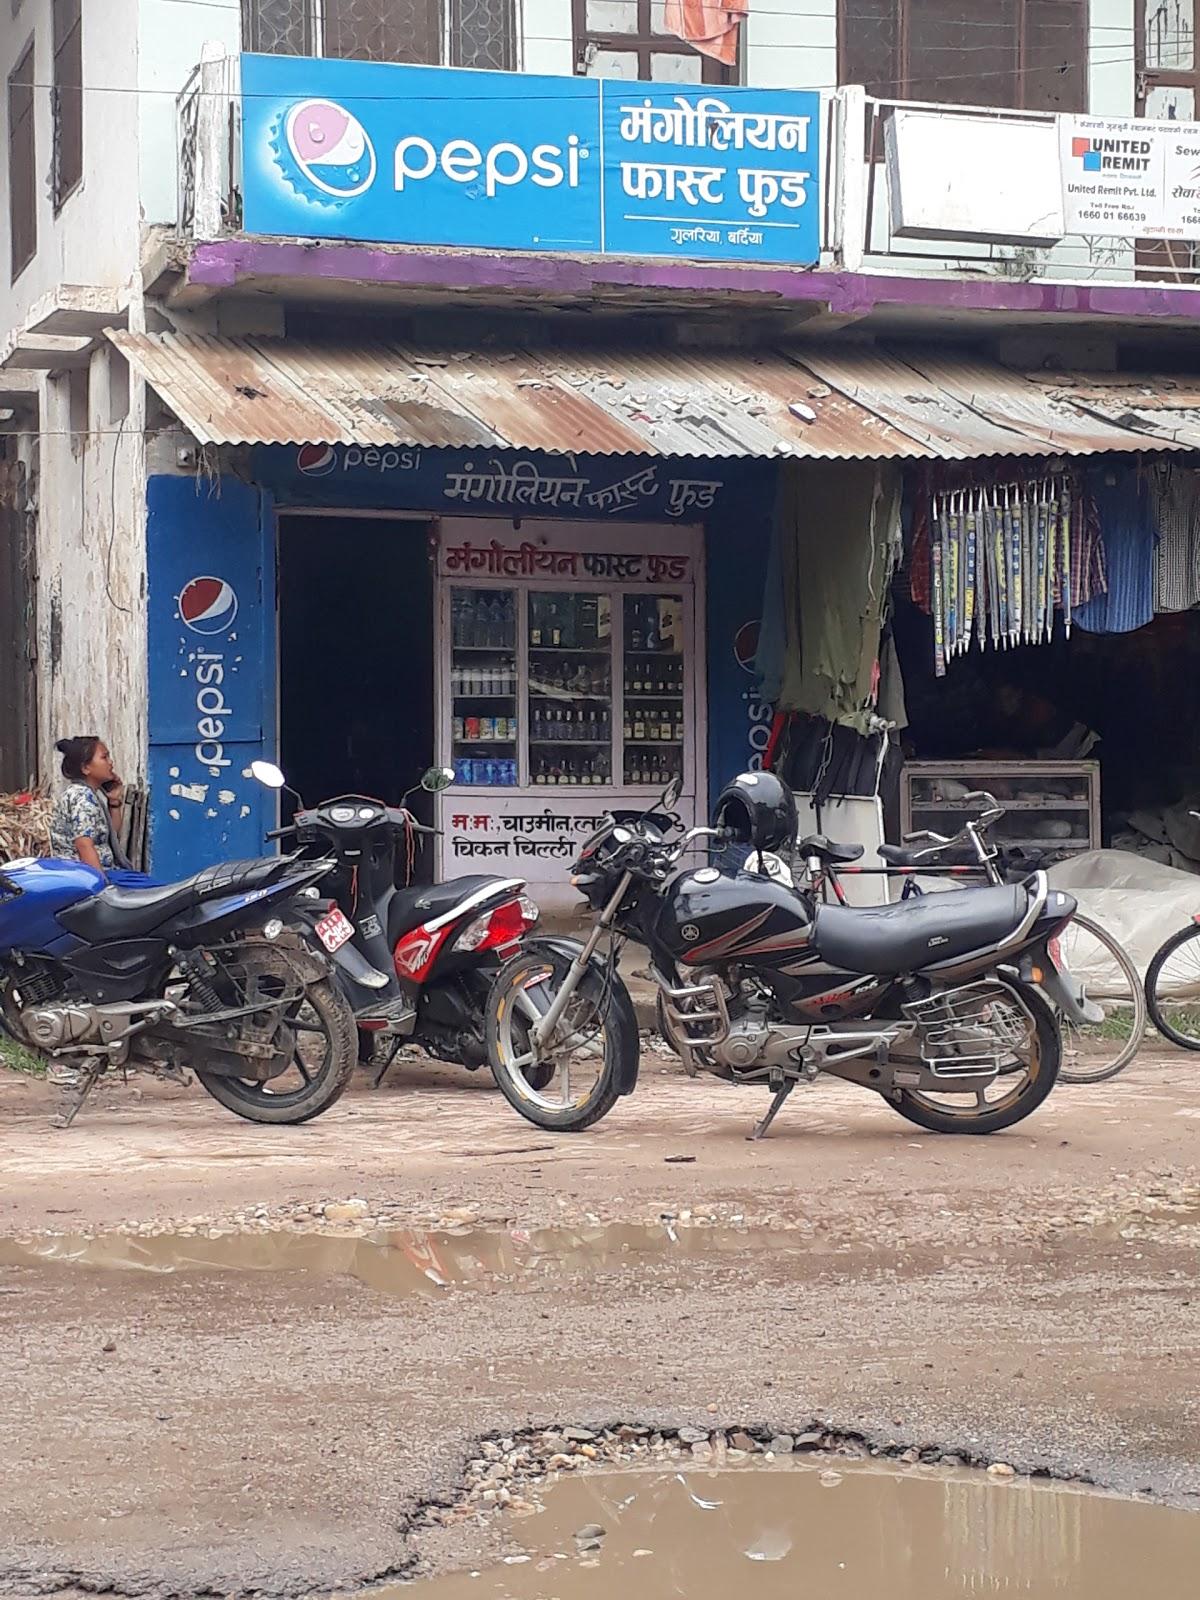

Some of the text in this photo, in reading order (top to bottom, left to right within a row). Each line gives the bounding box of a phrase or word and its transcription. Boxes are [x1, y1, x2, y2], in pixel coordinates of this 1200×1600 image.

[620, 97, 811, 152] मंगोलियन
[394, 134, 578, 197] pepsi
[1093, 138, 1151, 154] UNITED
[1102, 156, 1150, 171] REMIT
[620, 162, 810, 217] फास्ट फुड
[1067, 184, 1096, 194] United
[1097, 185, 1121, 196] Remit
[344, 448, 421, 473] pepsi
[189, 651, 232, 766] pepsi
